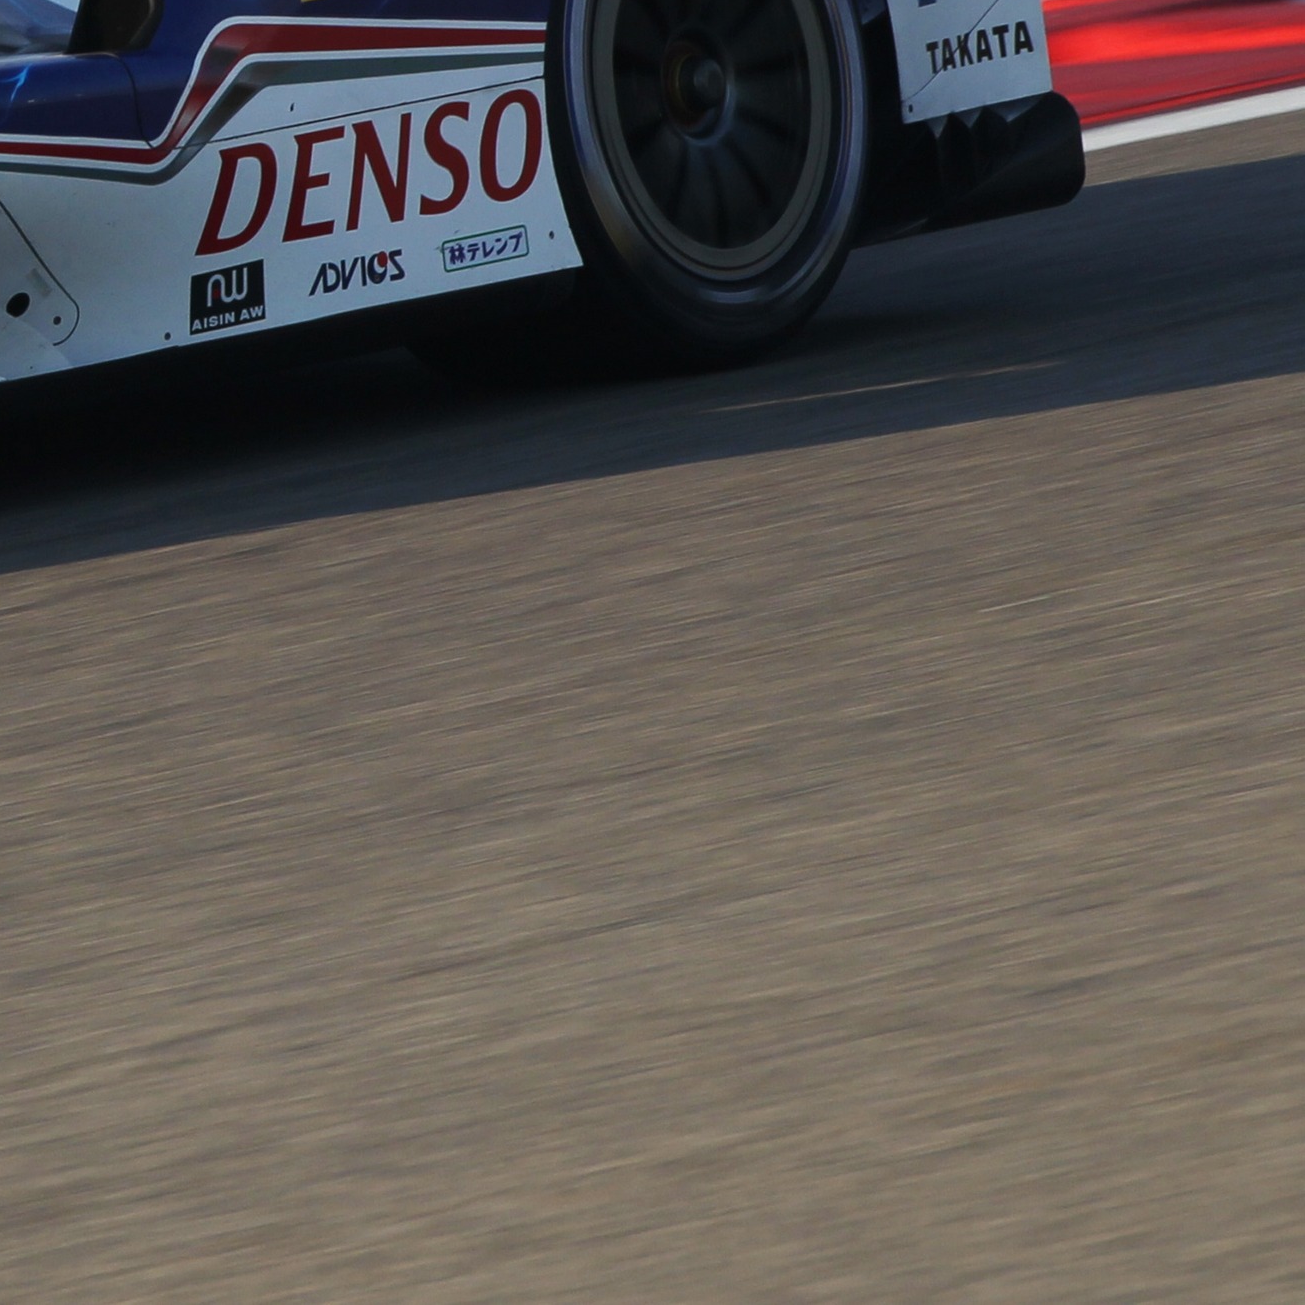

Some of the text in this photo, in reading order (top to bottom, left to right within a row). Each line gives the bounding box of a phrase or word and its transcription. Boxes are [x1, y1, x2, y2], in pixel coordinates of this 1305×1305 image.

[926, 20, 1034, 74] TAKATA
[195, 88, 544, 256] DENSO
[448, 232, 523, 265] 林テレンプ
[309, 249, 405, 297] ADVICS
[191, 305, 265, 333] AISIN AW
